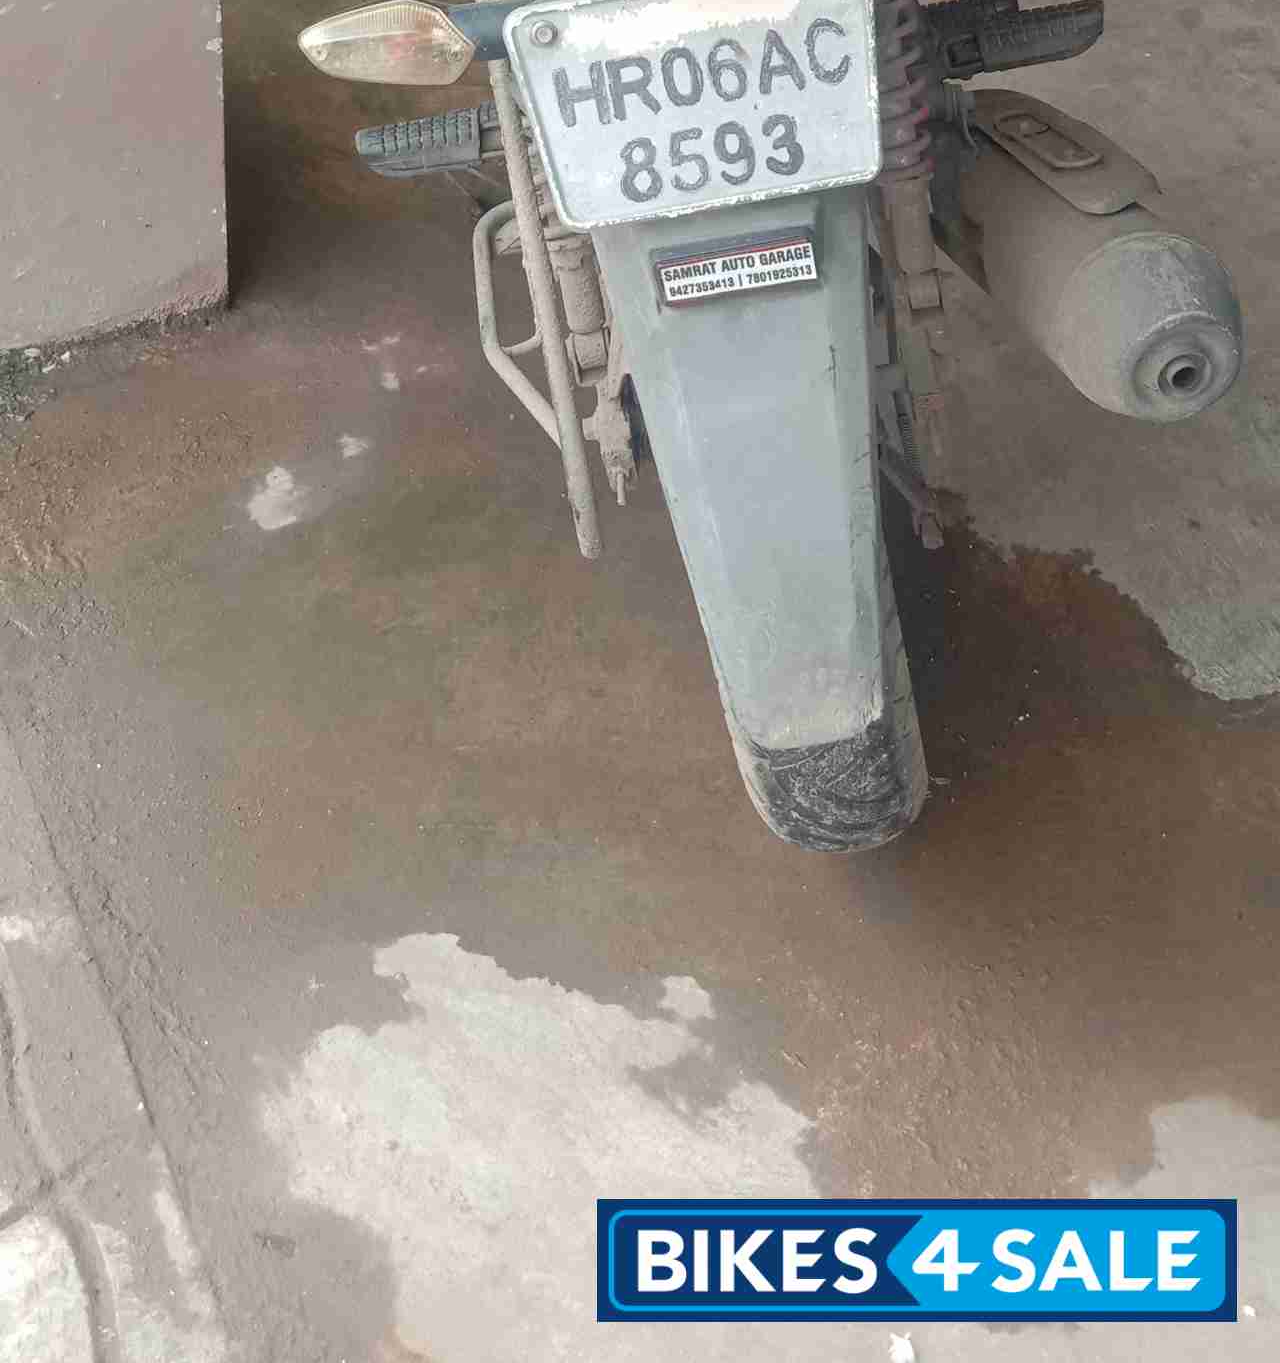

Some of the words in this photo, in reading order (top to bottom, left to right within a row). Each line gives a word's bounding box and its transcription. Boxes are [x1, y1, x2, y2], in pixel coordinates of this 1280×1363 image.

[551, 17, 852, 128] HR06AC
[619, 114, 804, 203] 8593
[663, 261, 717, 282] SAMRAT
[721, 255, 755, 273] AUTO
[759, 245, 811, 266] GARAGE
